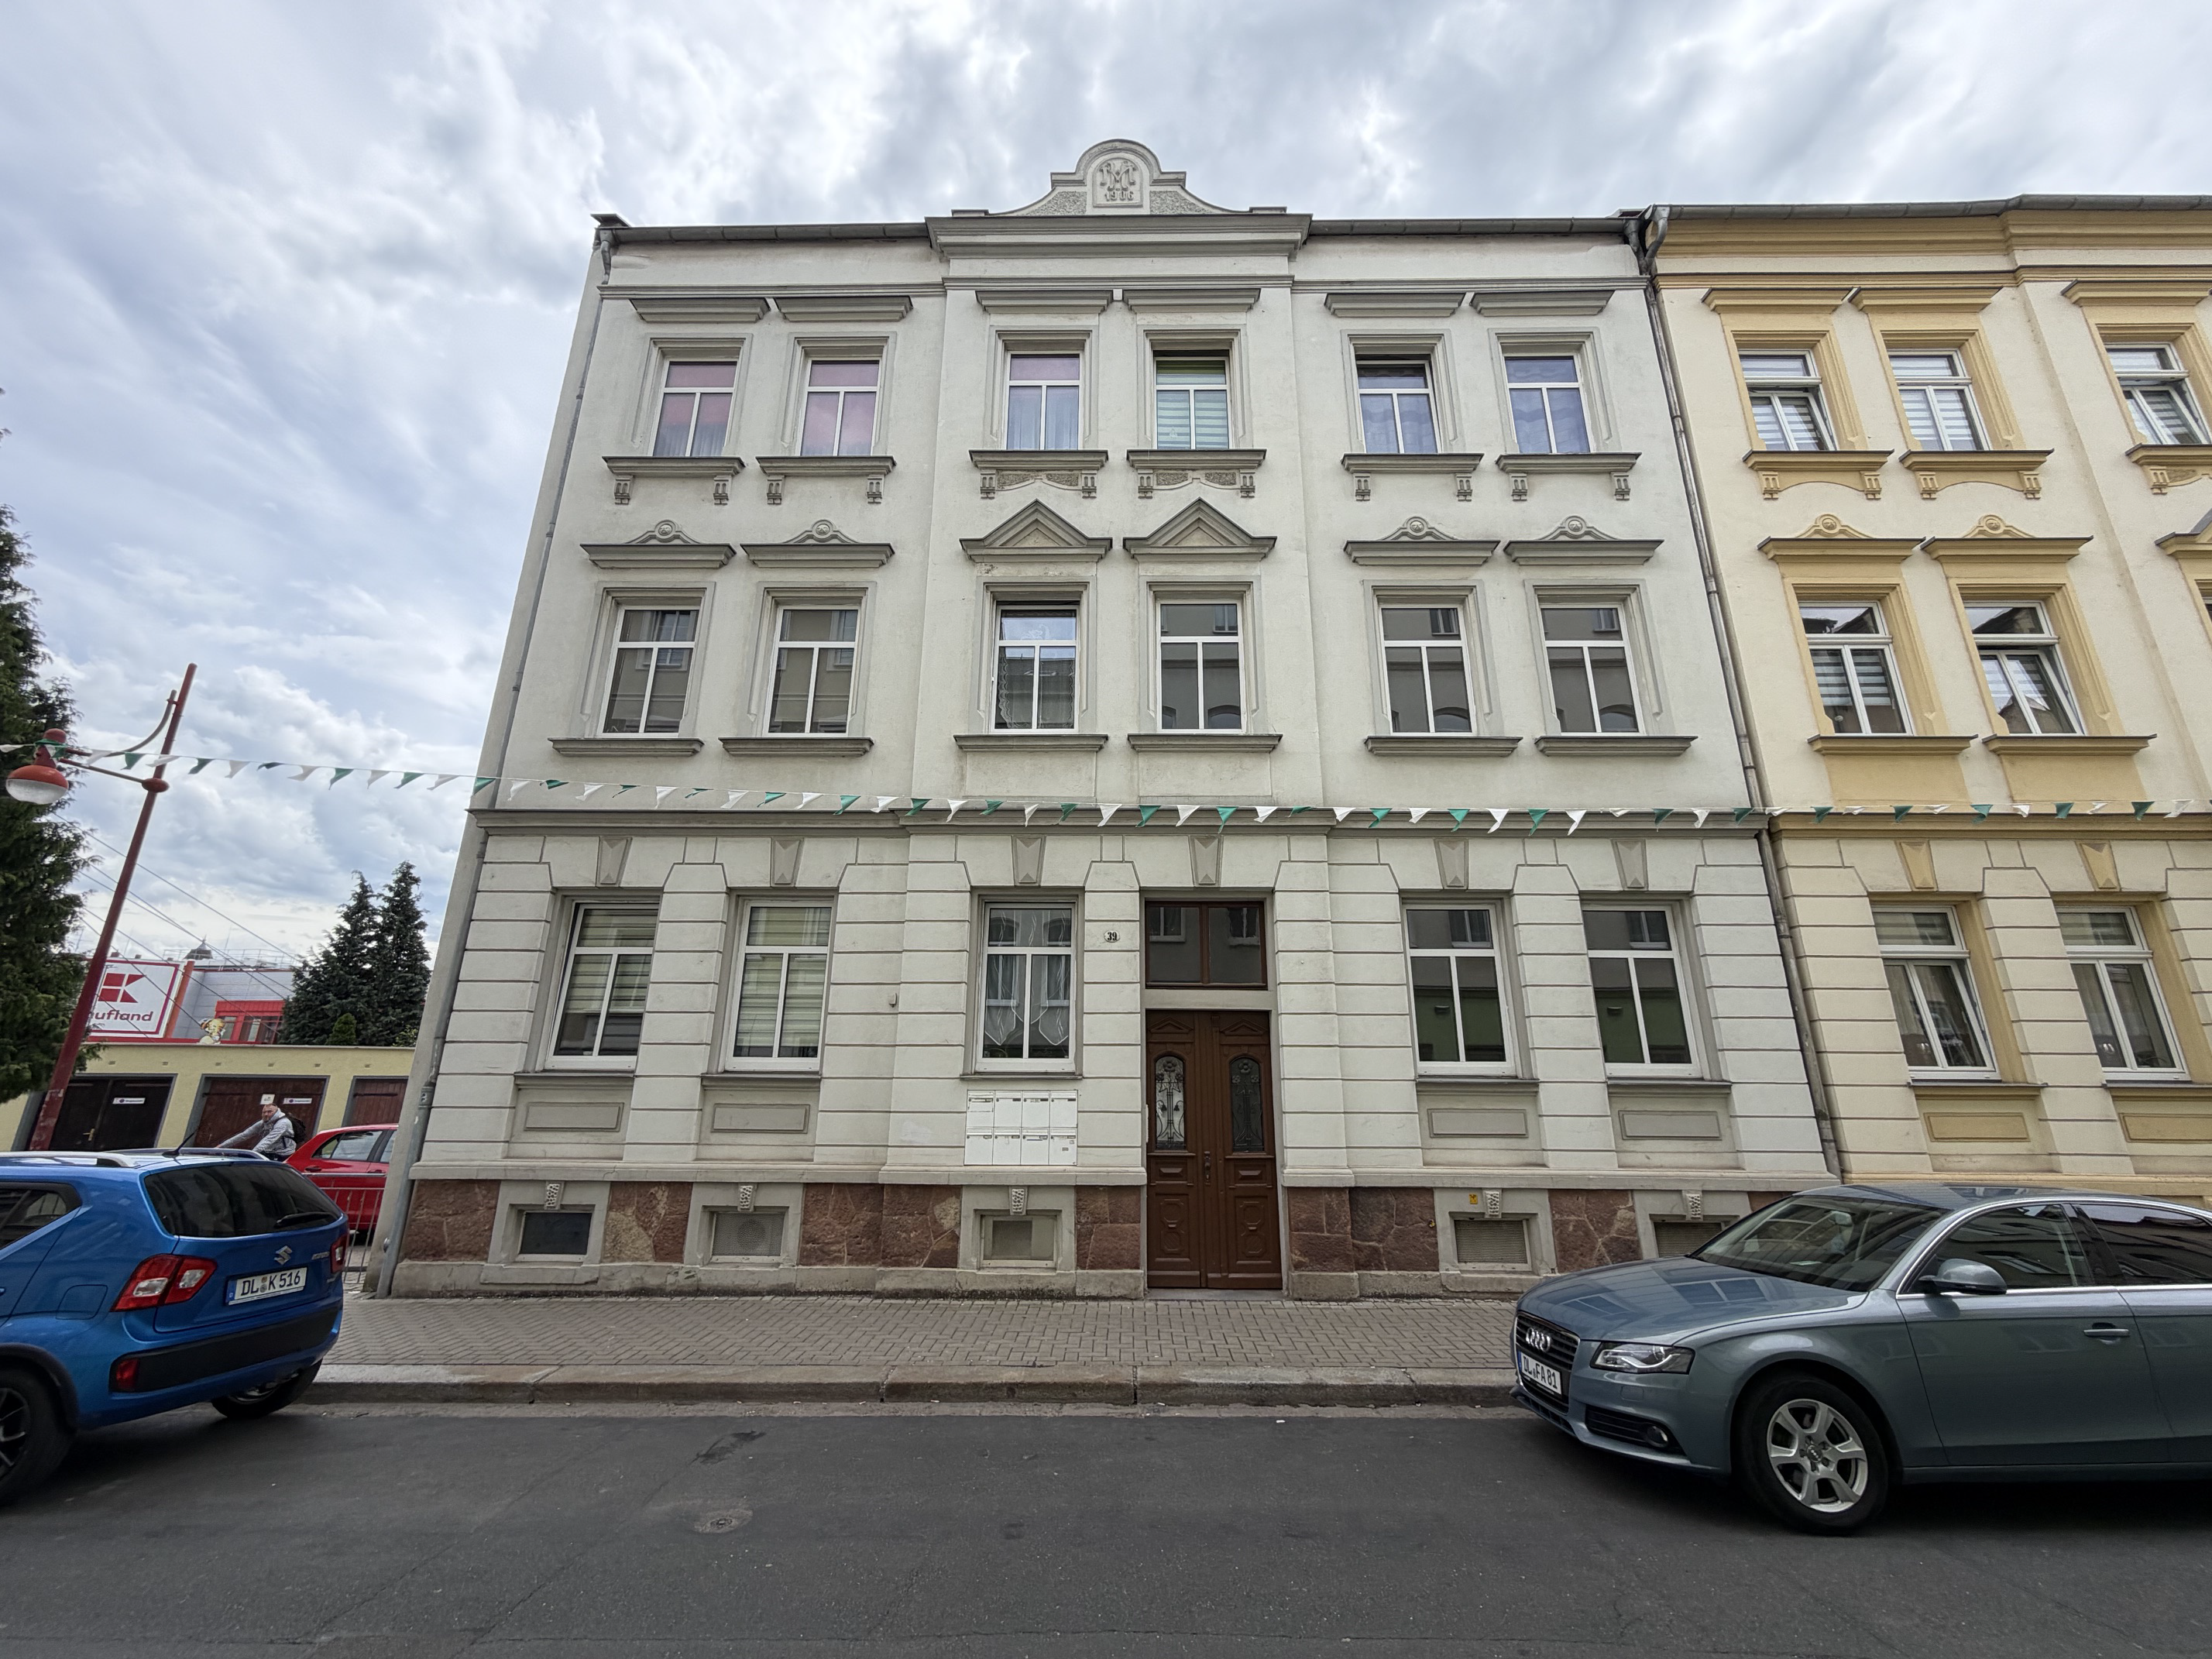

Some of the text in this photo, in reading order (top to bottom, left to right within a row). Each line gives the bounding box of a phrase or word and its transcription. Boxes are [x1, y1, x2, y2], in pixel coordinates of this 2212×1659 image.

[1104, 191, 1134, 201] 1906
[1107, 931, 1118, 941] 39
[91, 1009, 154, 1022] ufland
[240, 1279, 259, 1296] DL
[268, 1275, 277, 1290] K
[279, 1271, 301, 1288] 516
[1523, 1355, 1533, 1376] DL
[1535, 1363, 1547, 1383] FA
[1547, 1369, 1558, 1390] 81
